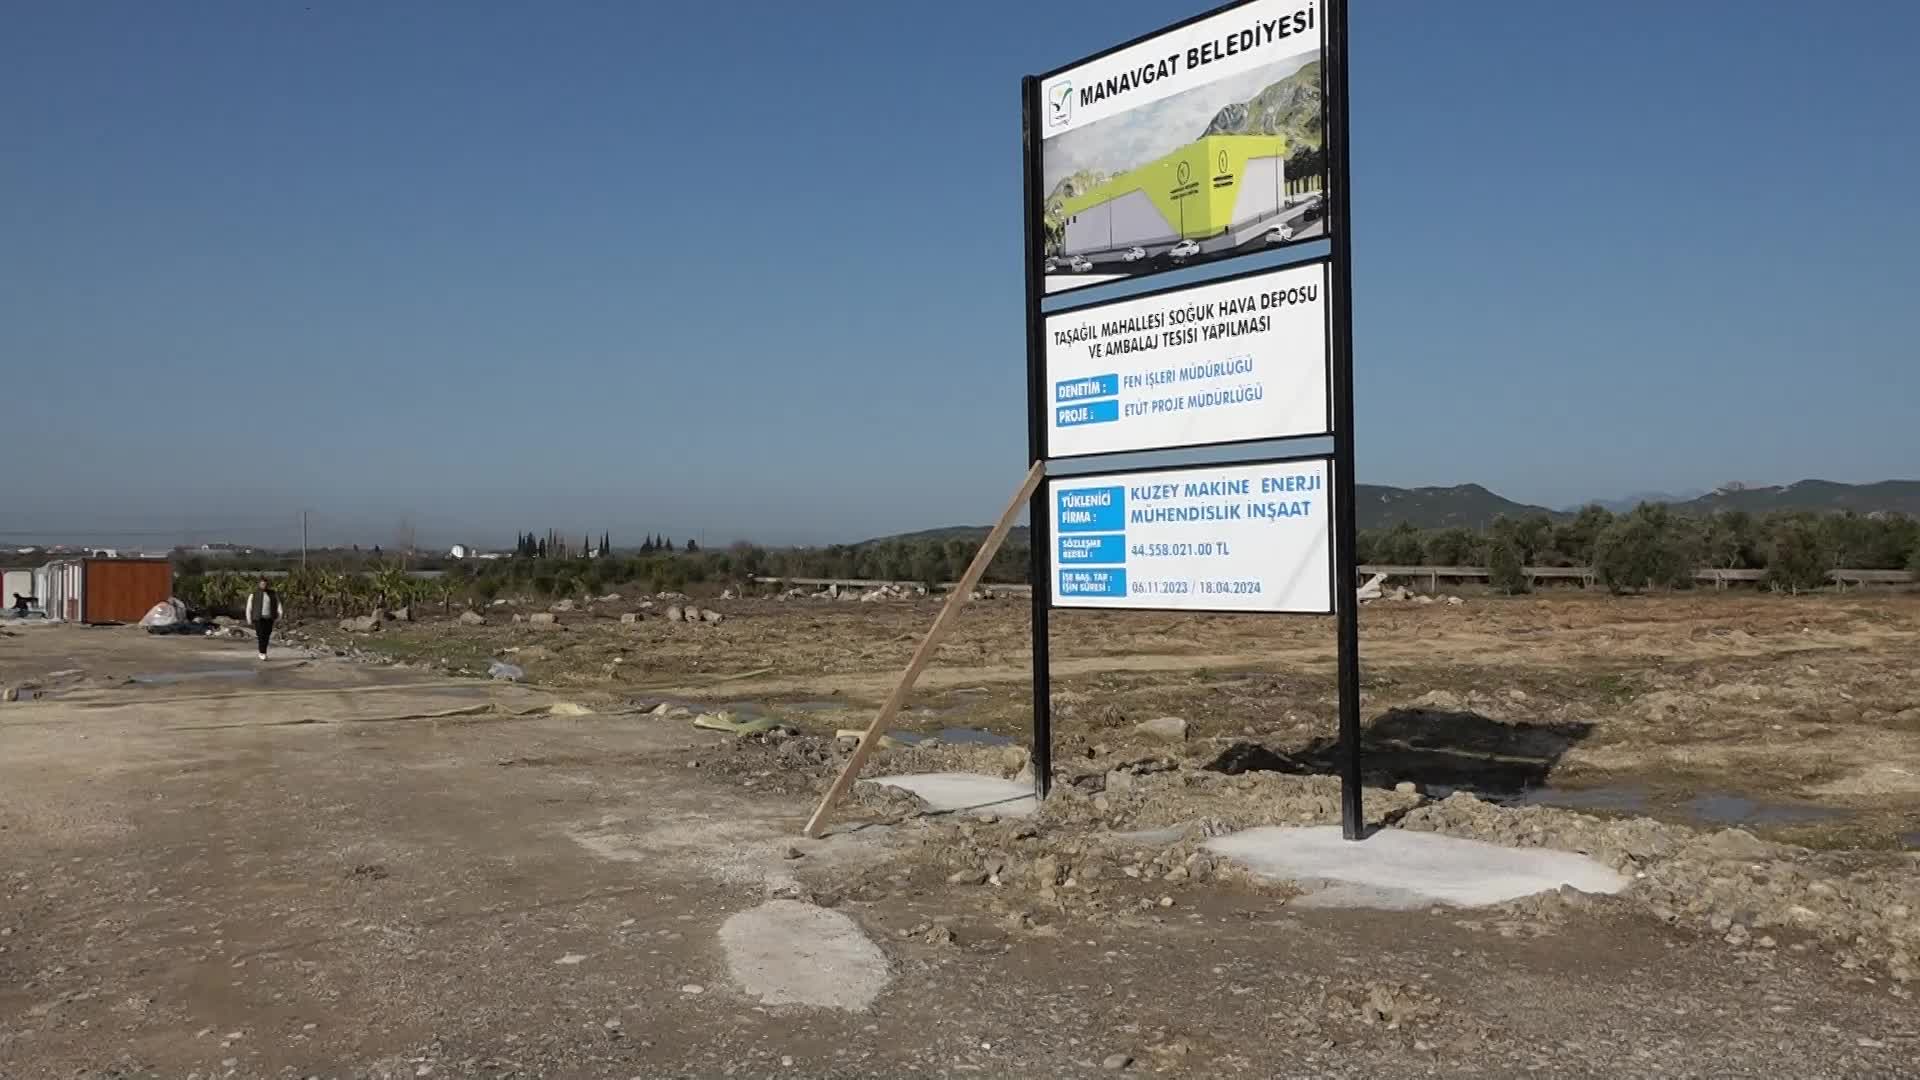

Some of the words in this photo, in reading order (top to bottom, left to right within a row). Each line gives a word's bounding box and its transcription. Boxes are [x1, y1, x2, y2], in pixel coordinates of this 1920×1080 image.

[1079, 54, 1180, 107] MANAVGAT
[1186, 2, 1315, 70] BELEDİYESİ
[1054, 322, 1097, 347] TAŞAĞIL
[1101, 308, 1165, 338] MAHALLESİ
[1169, 302, 1215, 326] SOĞUK
[1219, 296, 1256, 317] HAVA
[1261, 284, 1318, 310] DEPOSU
[1088, 343, 1103, 359] VE
[1105, 333, 1158, 357] AMBALAJ
[1162, 321, 1198, 348] TESİSİ
[1202, 315, 1271, 342] YAPILMASI
[1123, 375, 1142, 389] FEN
[1145, 363, 1176, 389] İŞLERİ
[1179, 354, 1253, 382] MÜDÜRLÜĞÜ
[1058, 378, 1101, 398] DENETİM
[1124, 398, 1149, 417] ETÜT
[1151, 396, 1185, 413] PROJE
[1187, 382, 1264, 409] MÜDÜRLÜĞÜ
[1059, 407, 1089, 424] PROJE
[1131, 484, 1180, 501] KUZEY
[1184, 475, 1251, 498] MAKİNE
[1261, 469, 1322, 493] ENERJİ
[1061, 489, 1112, 509] YÜKLENİCİ
[1131, 502, 1240, 524] MÜHENDİSLİK
[1247, 499, 1312, 522] İNŞAAT
[1062, 509, 1092, 524] FİRMA
[1216, 540, 1230, 556] TL
[1131, 580, 1189, 594] 06.11.2023
[1199, 580, 1262, 595] 18.04.2024
